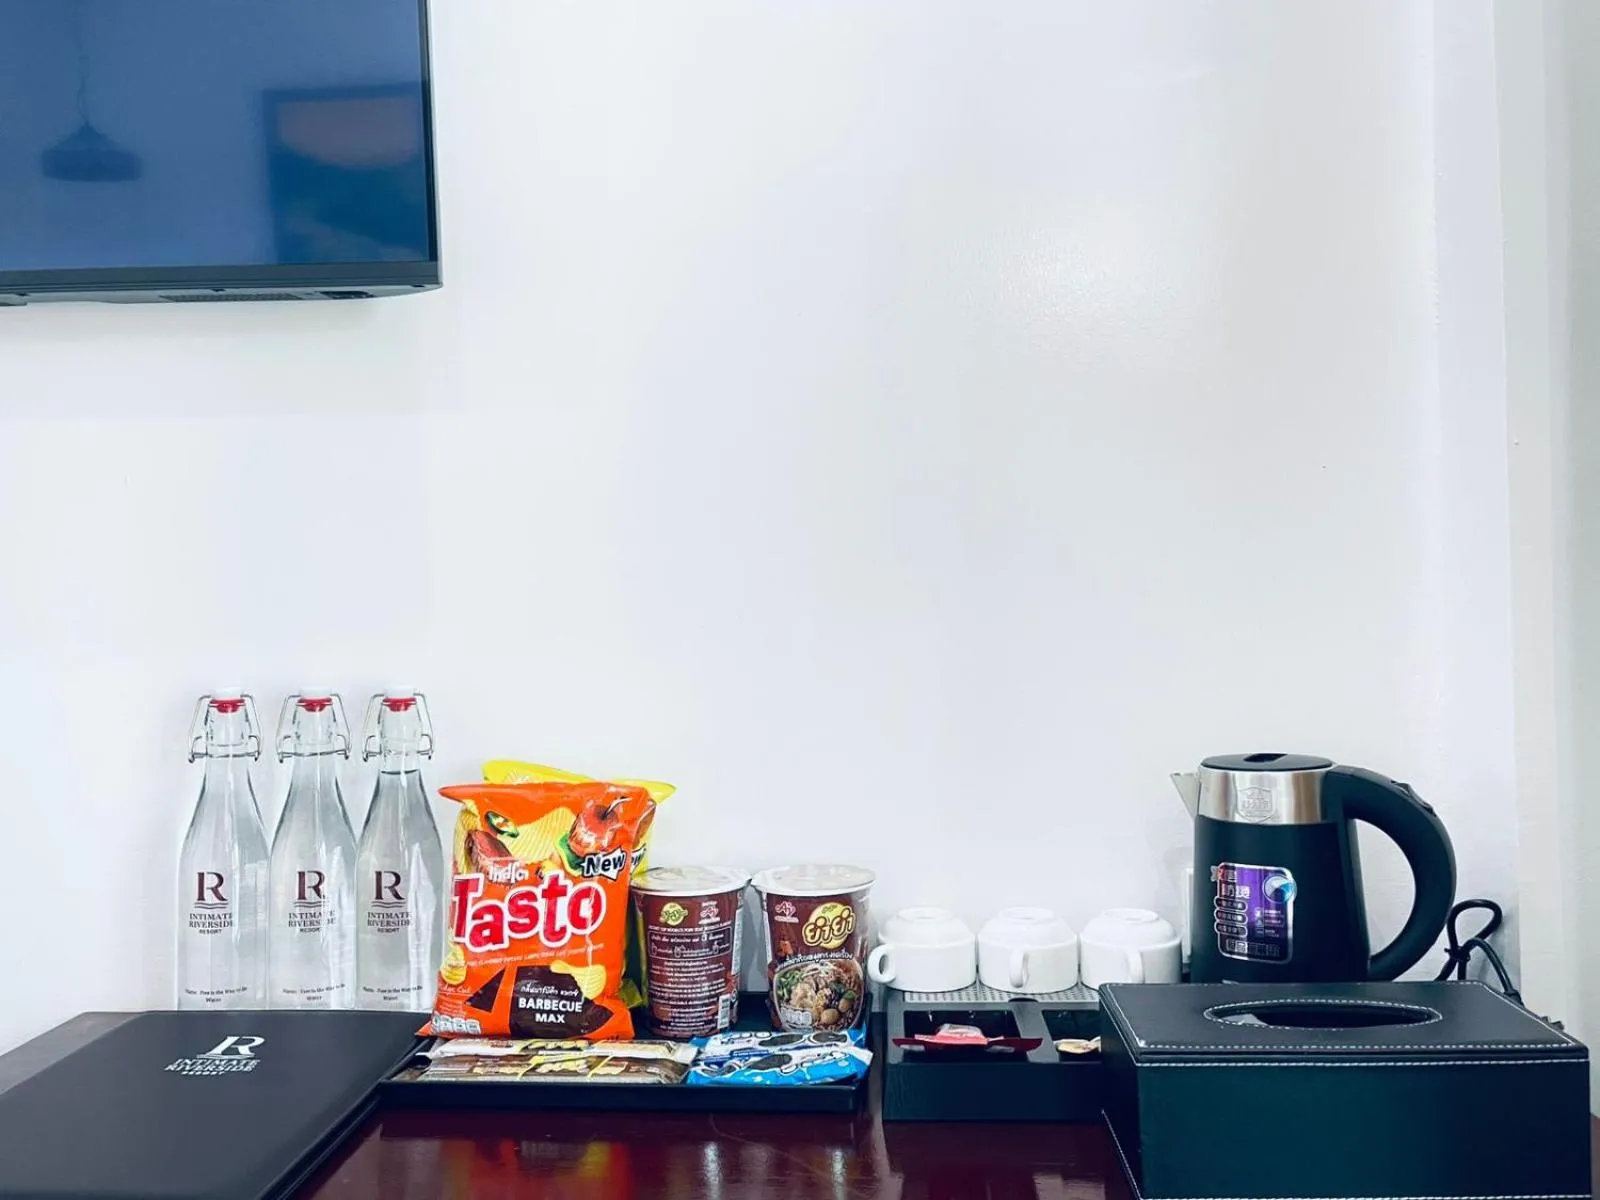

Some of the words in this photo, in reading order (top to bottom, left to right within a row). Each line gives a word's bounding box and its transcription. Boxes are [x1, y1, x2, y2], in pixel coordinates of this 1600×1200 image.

[586, 854, 625, 875] New
[197, 872, 228, 901] R
[297, 871, 326, 900] R
[375, 870, 405, 900] R
[453, 874, 605, 950] Tasto
[518, 997, 583, 1012] BARBECUE
[535, 1013, 566, 1023] MAX
[205, 1035, 265, 1055] R
